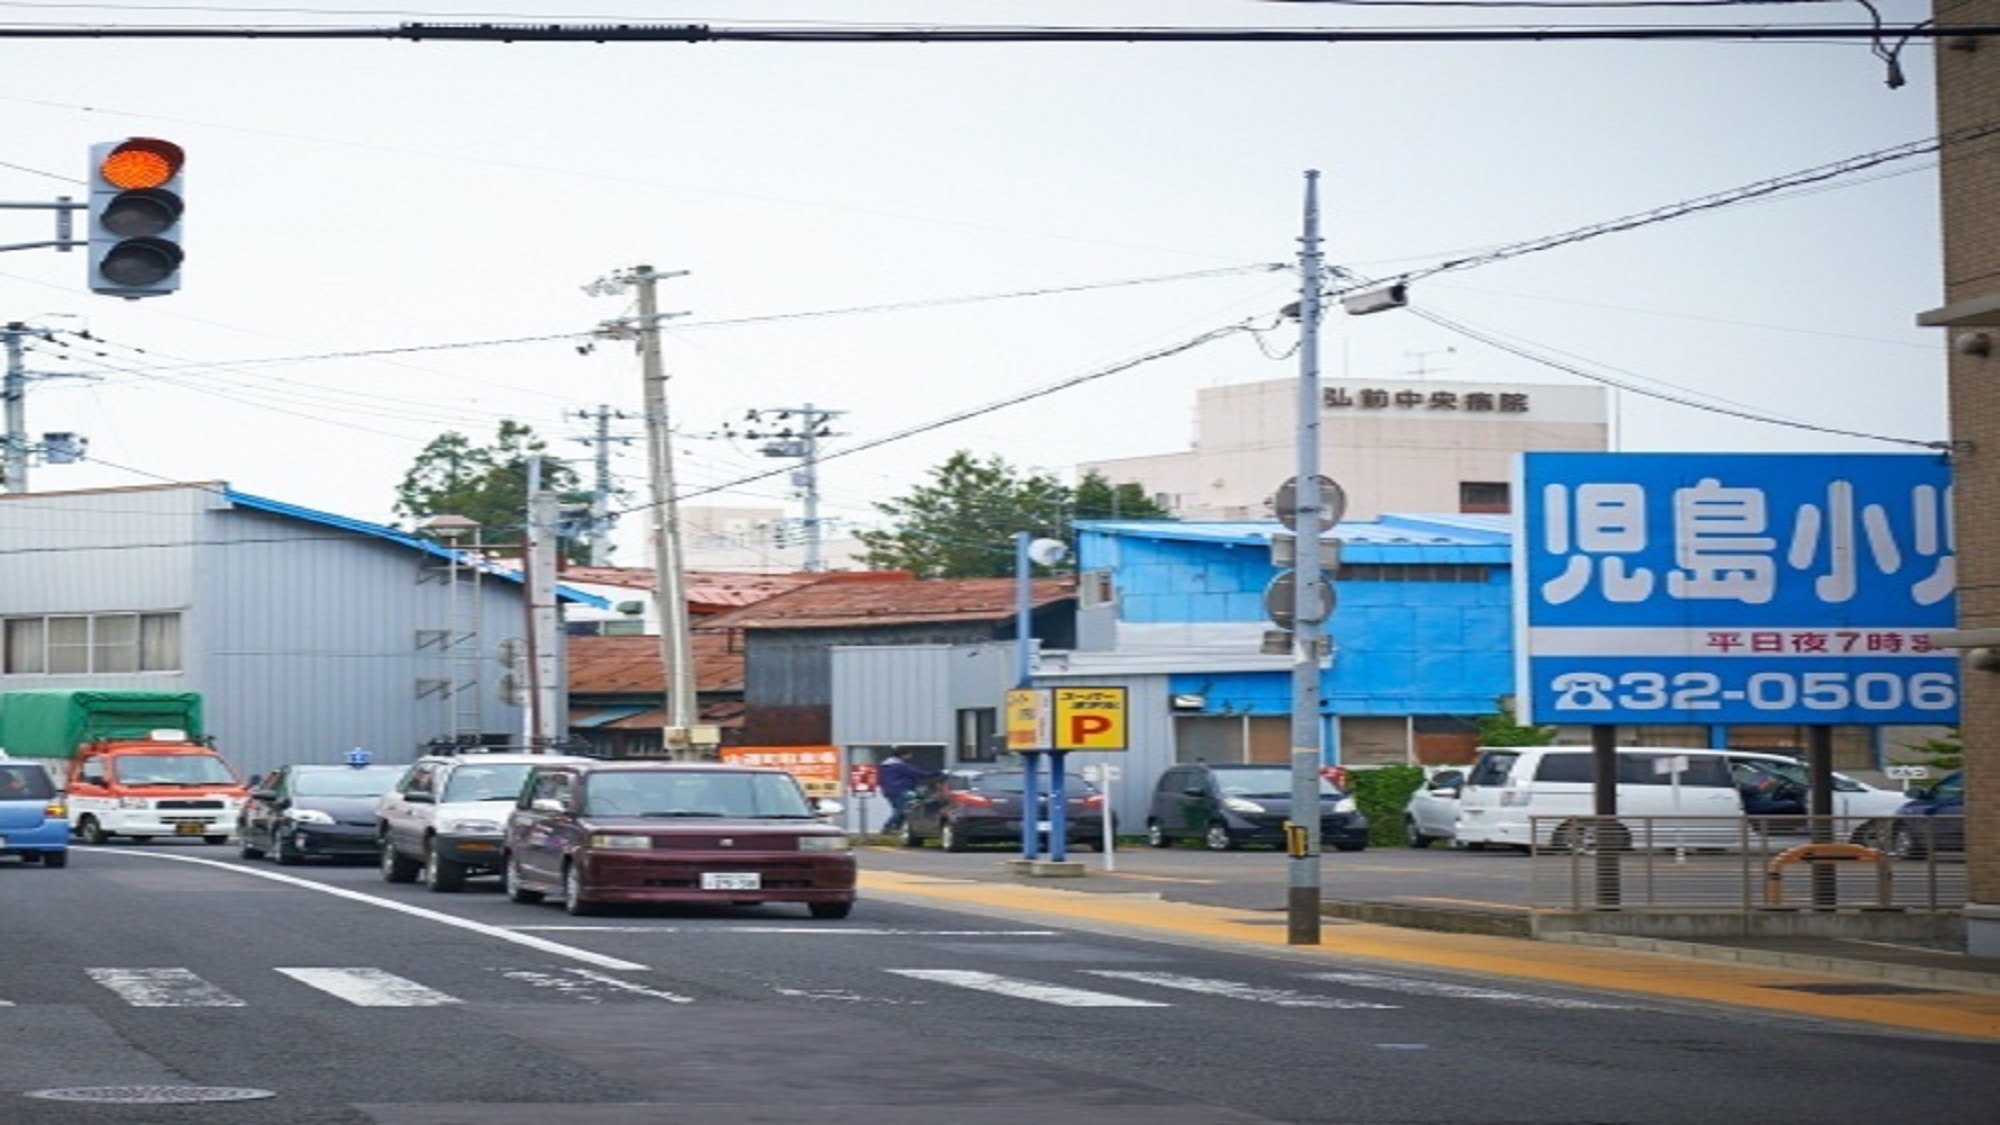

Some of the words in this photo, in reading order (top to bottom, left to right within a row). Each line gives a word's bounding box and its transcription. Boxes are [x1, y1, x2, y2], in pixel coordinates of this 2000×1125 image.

[1323, 388, 1529, 412] 弘前中央病院
[1619, 673, 1956, 709] 32-0506
[1071, 715, 1112, 744] P
